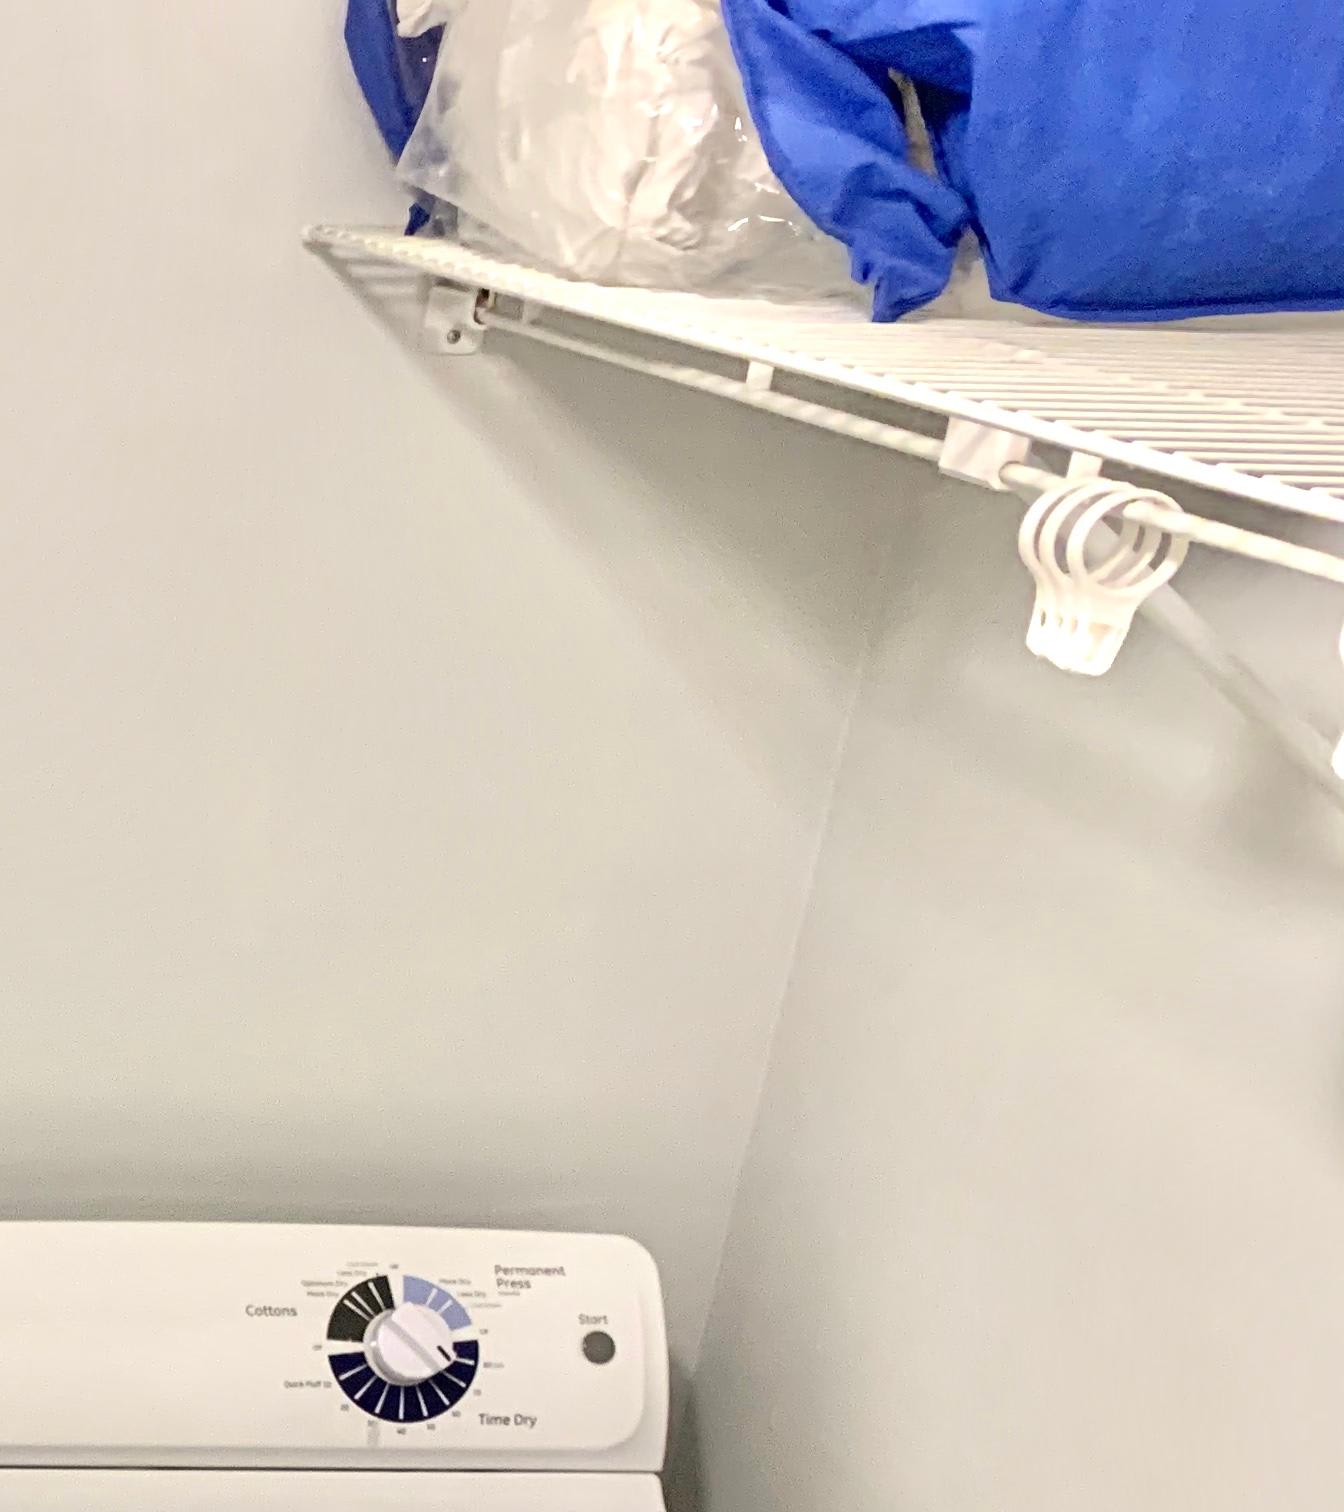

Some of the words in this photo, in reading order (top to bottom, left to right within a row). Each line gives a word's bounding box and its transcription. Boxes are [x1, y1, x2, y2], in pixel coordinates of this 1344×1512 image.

[494, 1264, 566, 1277] Permanent
[496, 1278, 532, 1290] Press
[245, 1304, 298, 1317] Cottons
[578, 1312, 609, 1325] Start
[478, 1413, 510, 1426] Time
[514, 1413, 538, 1428] Dry
